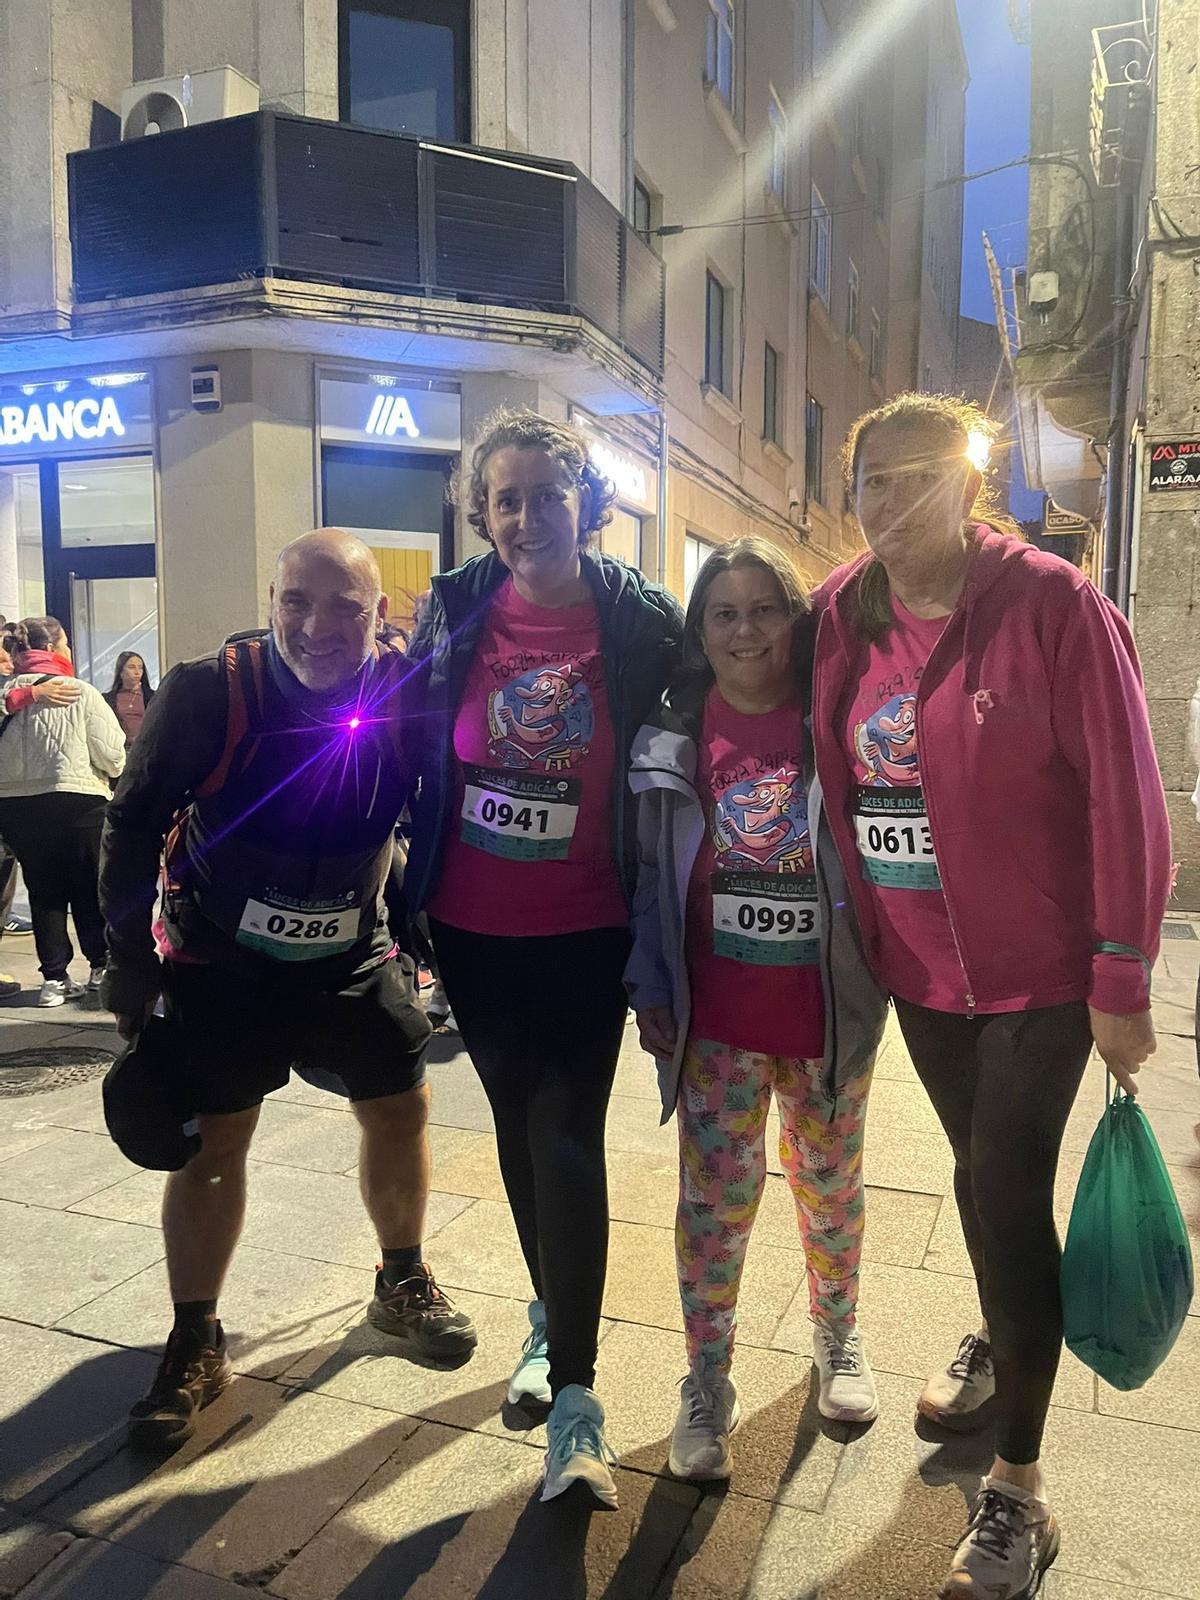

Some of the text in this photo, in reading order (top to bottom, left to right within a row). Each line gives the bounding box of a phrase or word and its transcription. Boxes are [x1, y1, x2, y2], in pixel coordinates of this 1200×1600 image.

[0, 397, 125, 445] BANCA
[507, 778, 519, 790] DE
[481, 798, 549, 834] 0941
[883, 797, 896, 808] DE
[897, 797, 926, 809] ADIC
[868, 825, 934, 855] 0613
[730, 879, 761, 889] LUCES
[763, 881, 777, 891] DE
[266, 914, 340, 939] 0286
[738, 904, 815, 934] 0993
